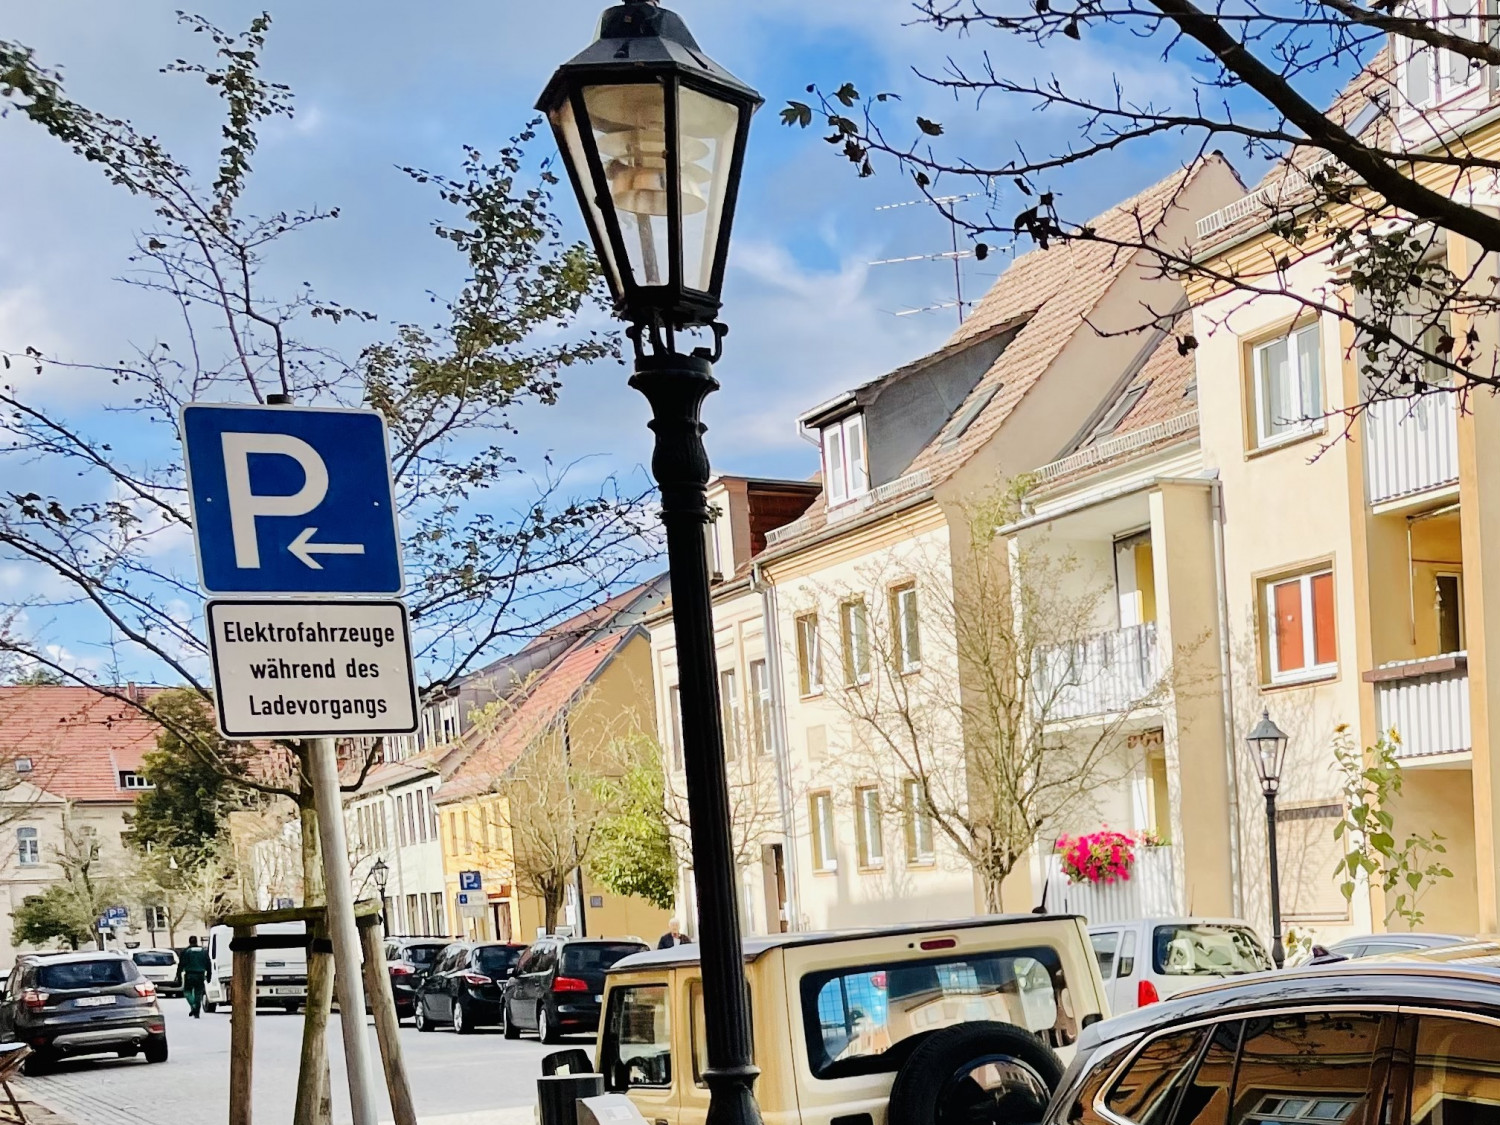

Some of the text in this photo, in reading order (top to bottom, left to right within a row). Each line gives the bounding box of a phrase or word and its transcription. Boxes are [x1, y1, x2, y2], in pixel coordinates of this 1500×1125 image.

[221, 432, 329, 569] P
[223, 621, 395, 647] Elektrofahrzeuge
[250, 657, 380, 679] während des
[249, 695, 388, 719] Ladevorgangs
[462, 873, 475, 889] P
